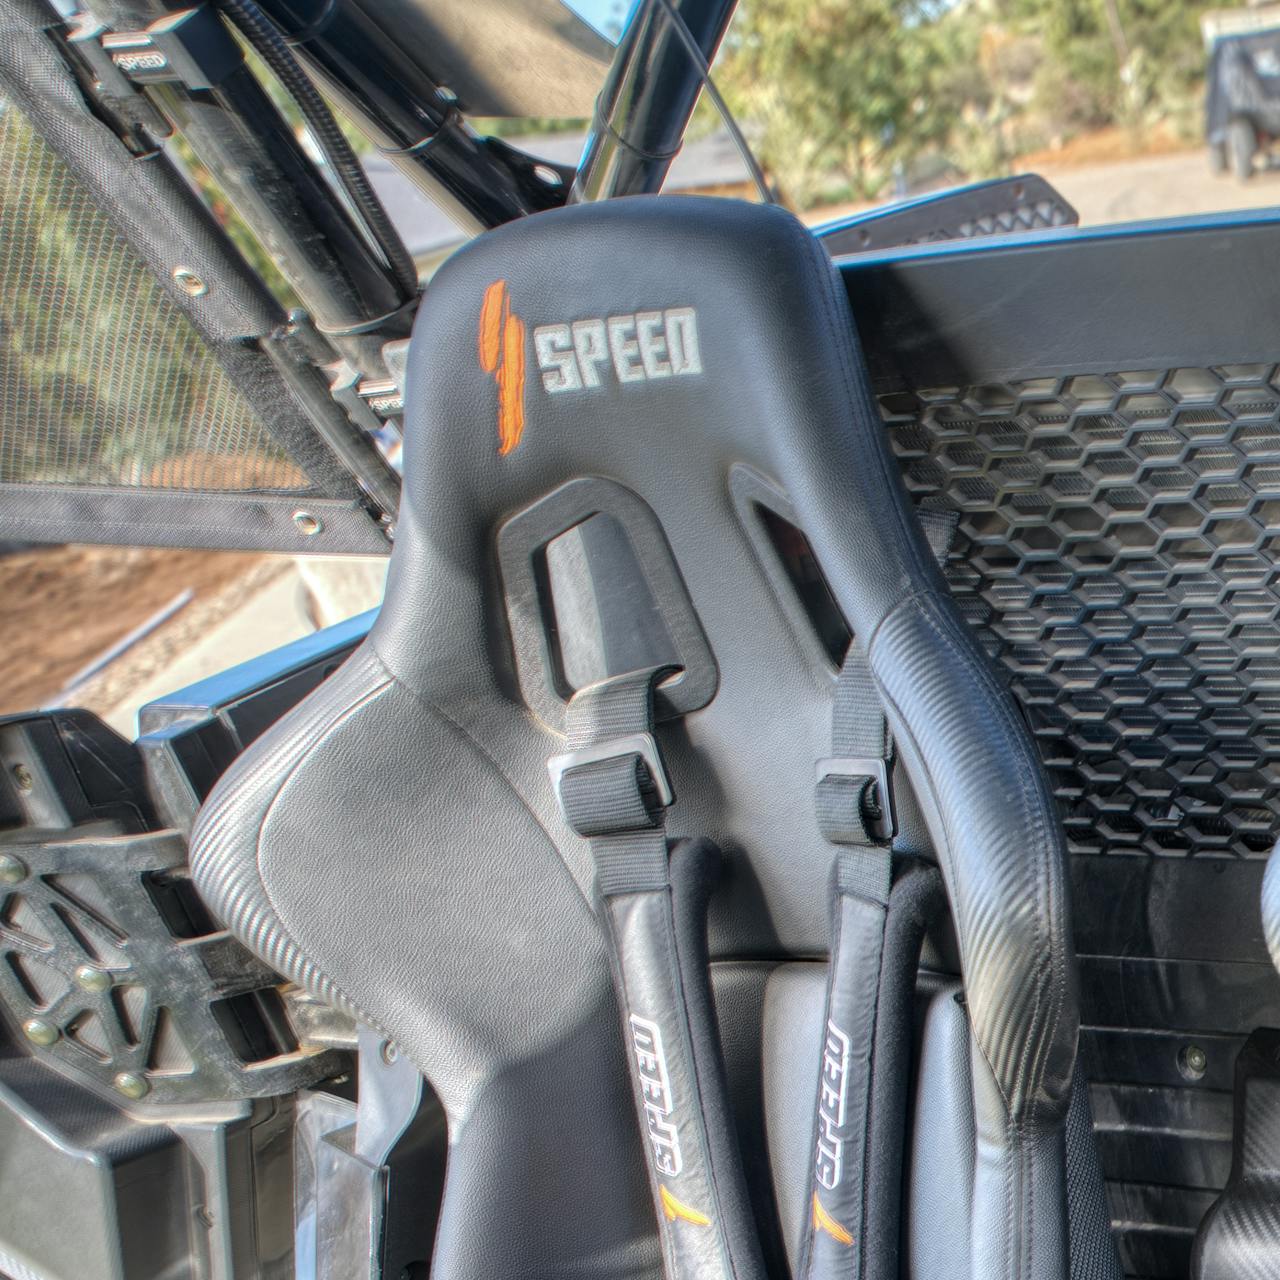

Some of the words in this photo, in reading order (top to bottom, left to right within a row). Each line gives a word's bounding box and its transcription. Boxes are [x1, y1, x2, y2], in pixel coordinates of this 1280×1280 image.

[534, 306, 703, 395] SPEED
[629, 1012, 682, 1178] SPEED
[815, 1017, 850, 1190] SPEED
